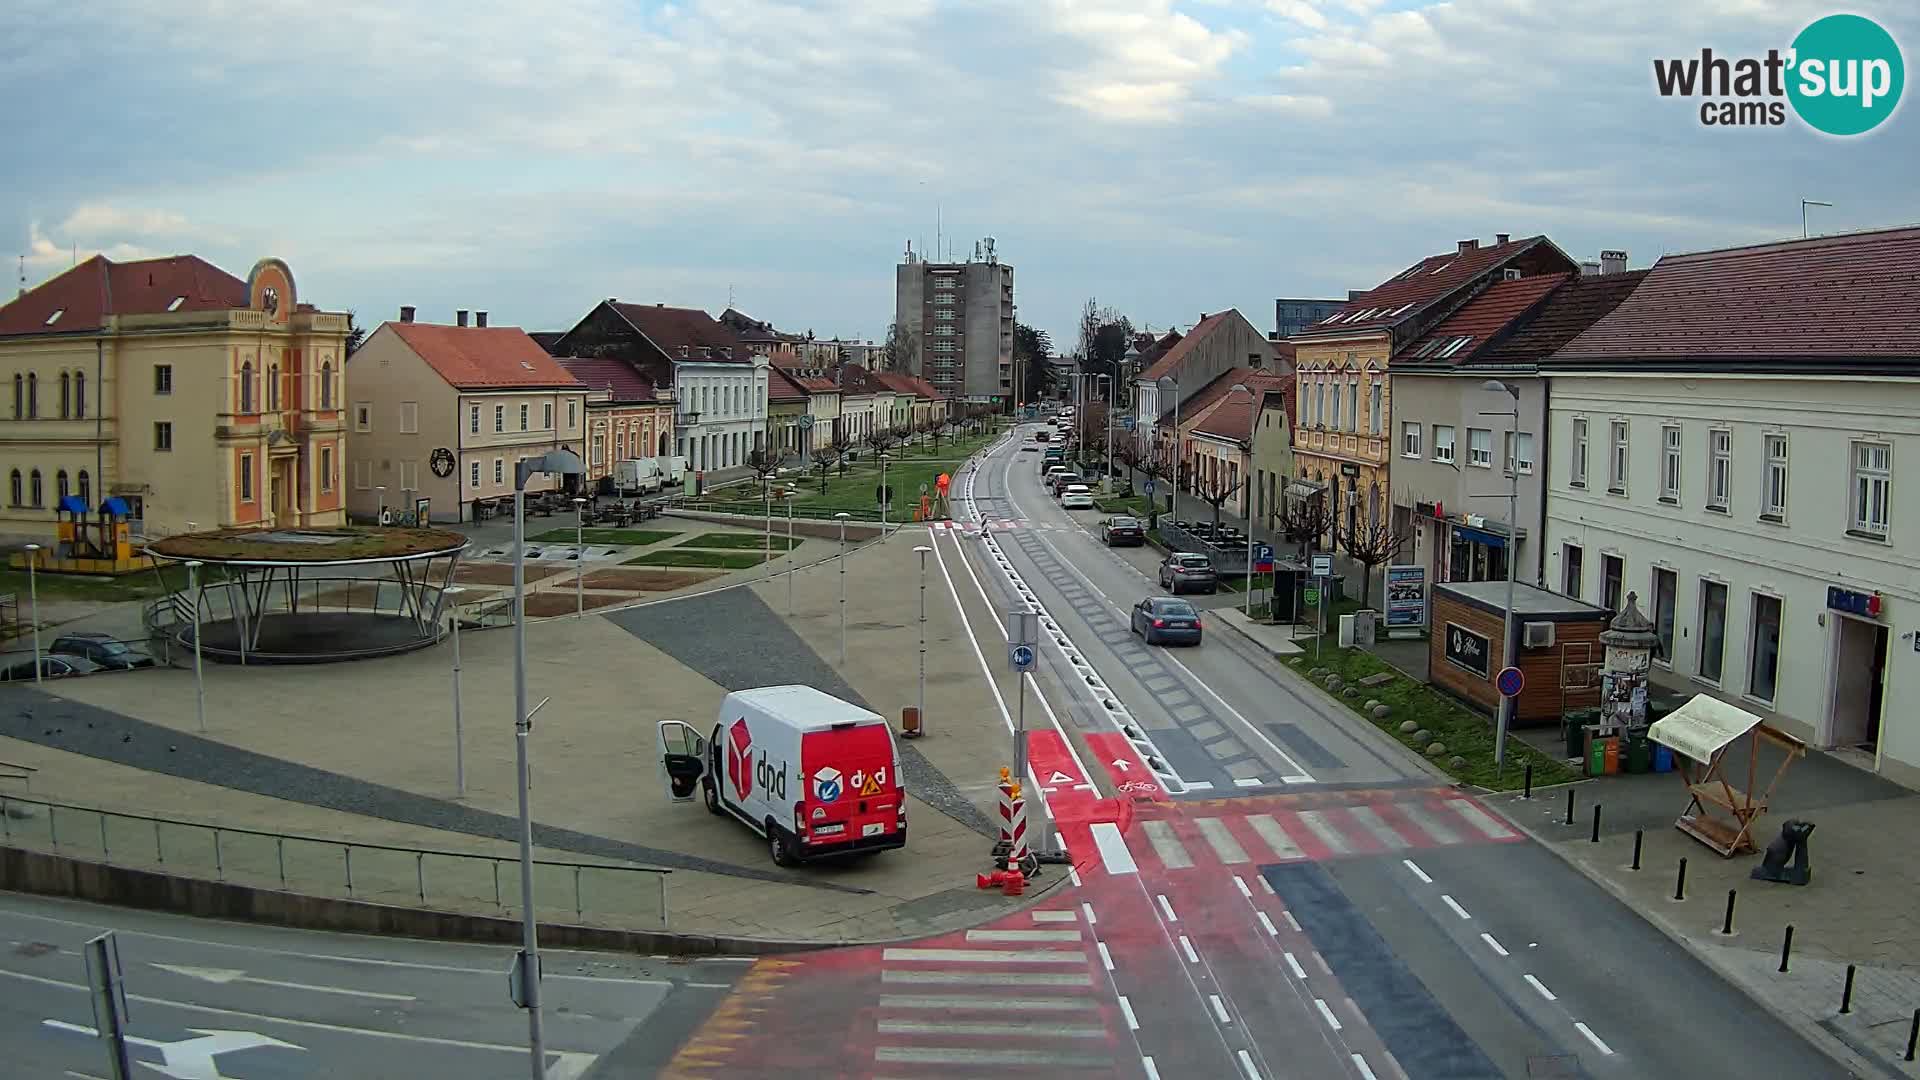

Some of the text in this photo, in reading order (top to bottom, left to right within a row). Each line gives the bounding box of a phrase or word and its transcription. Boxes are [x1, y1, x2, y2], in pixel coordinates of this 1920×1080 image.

[1260, 547, 1269, 559] P
[757, 750, 787, 801] dpd
[850, 766, 886, 788] dd
